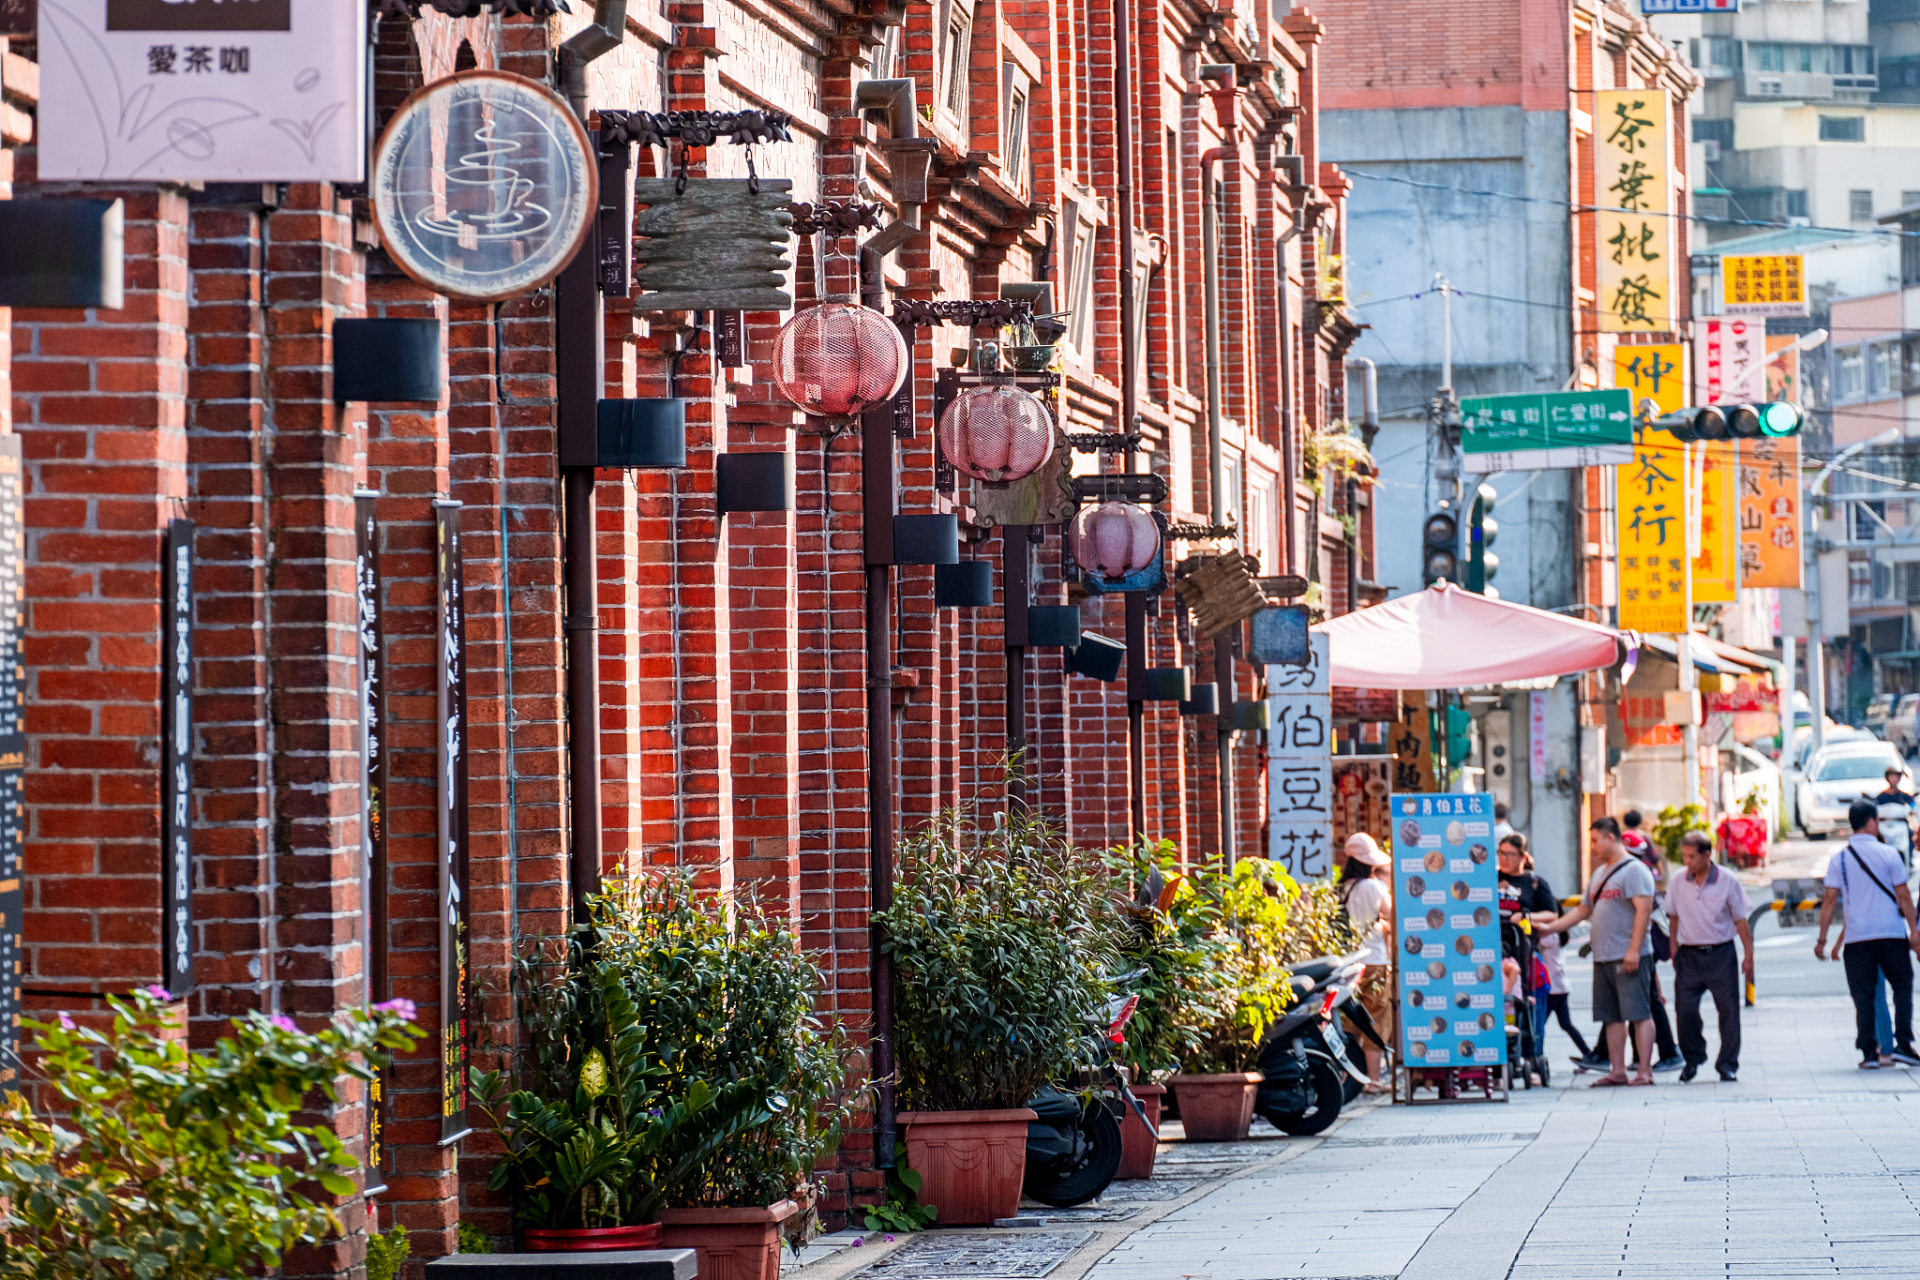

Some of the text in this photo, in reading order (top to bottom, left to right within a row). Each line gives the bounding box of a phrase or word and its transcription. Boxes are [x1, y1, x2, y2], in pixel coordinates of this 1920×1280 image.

[147, 45, 250, 75] 愛茶咖
[1606, 100, 1660, 326] 茶葉批發
[1551, 403, 1606, 422] 仁愛街
[1422, 797, 1483, 815] 勇伯豆花
